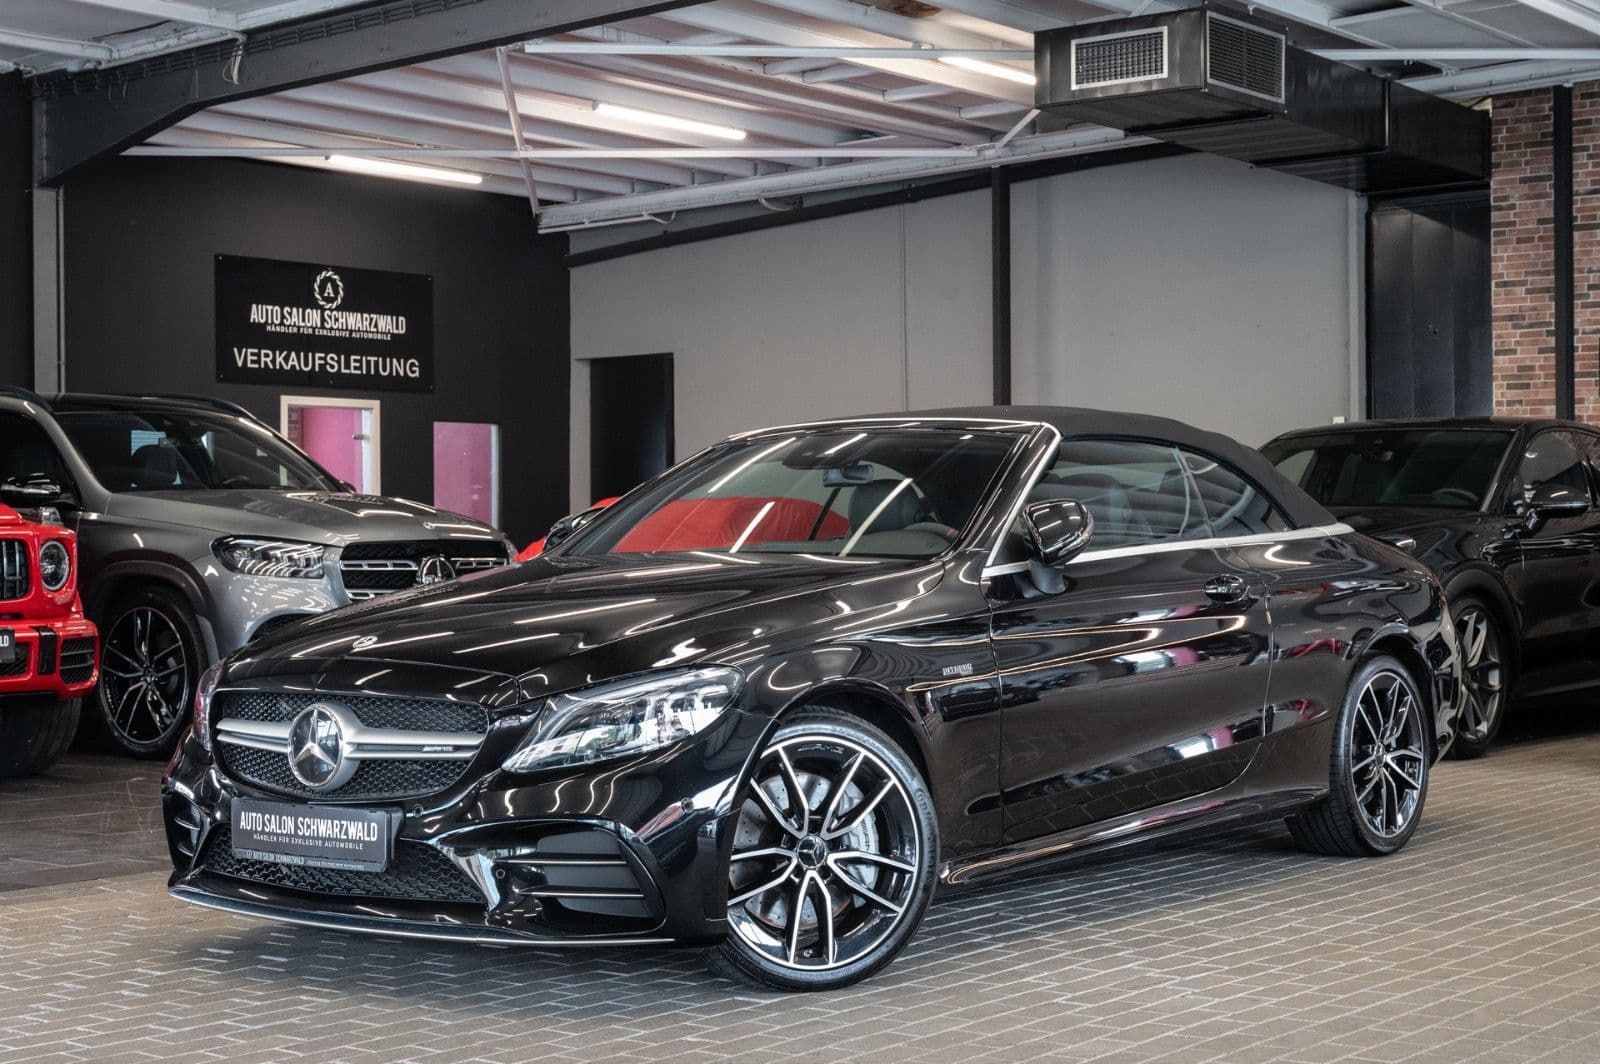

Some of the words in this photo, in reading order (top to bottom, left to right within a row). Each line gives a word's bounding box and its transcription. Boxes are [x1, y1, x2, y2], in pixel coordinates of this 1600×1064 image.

[324, 282, 335, 297] A
[250, 303, 280, 324] AUTO
[283, 306, 321, 327] SALON
[324, 309, 406, 335] SCHWARZWALD
[266, 325, 298, 334] HÄNDLER
[300, 327, 313, 335] FÜR
[352, 332, 391, 341] AUTOMOBILE
[233, 347, 420, 378] VERKAUFSLEITUNG
[240, 811, 263, 832] AUTO
[264, 814, 295, 835] SALON
[297, 817, 378, 842] SCHWARZWALD
[253, 833, 277, 843] HÄNDLER
[278, 836, 290, 844] FÜR
[324, 840, 364, 850] AUTOMOBILE
